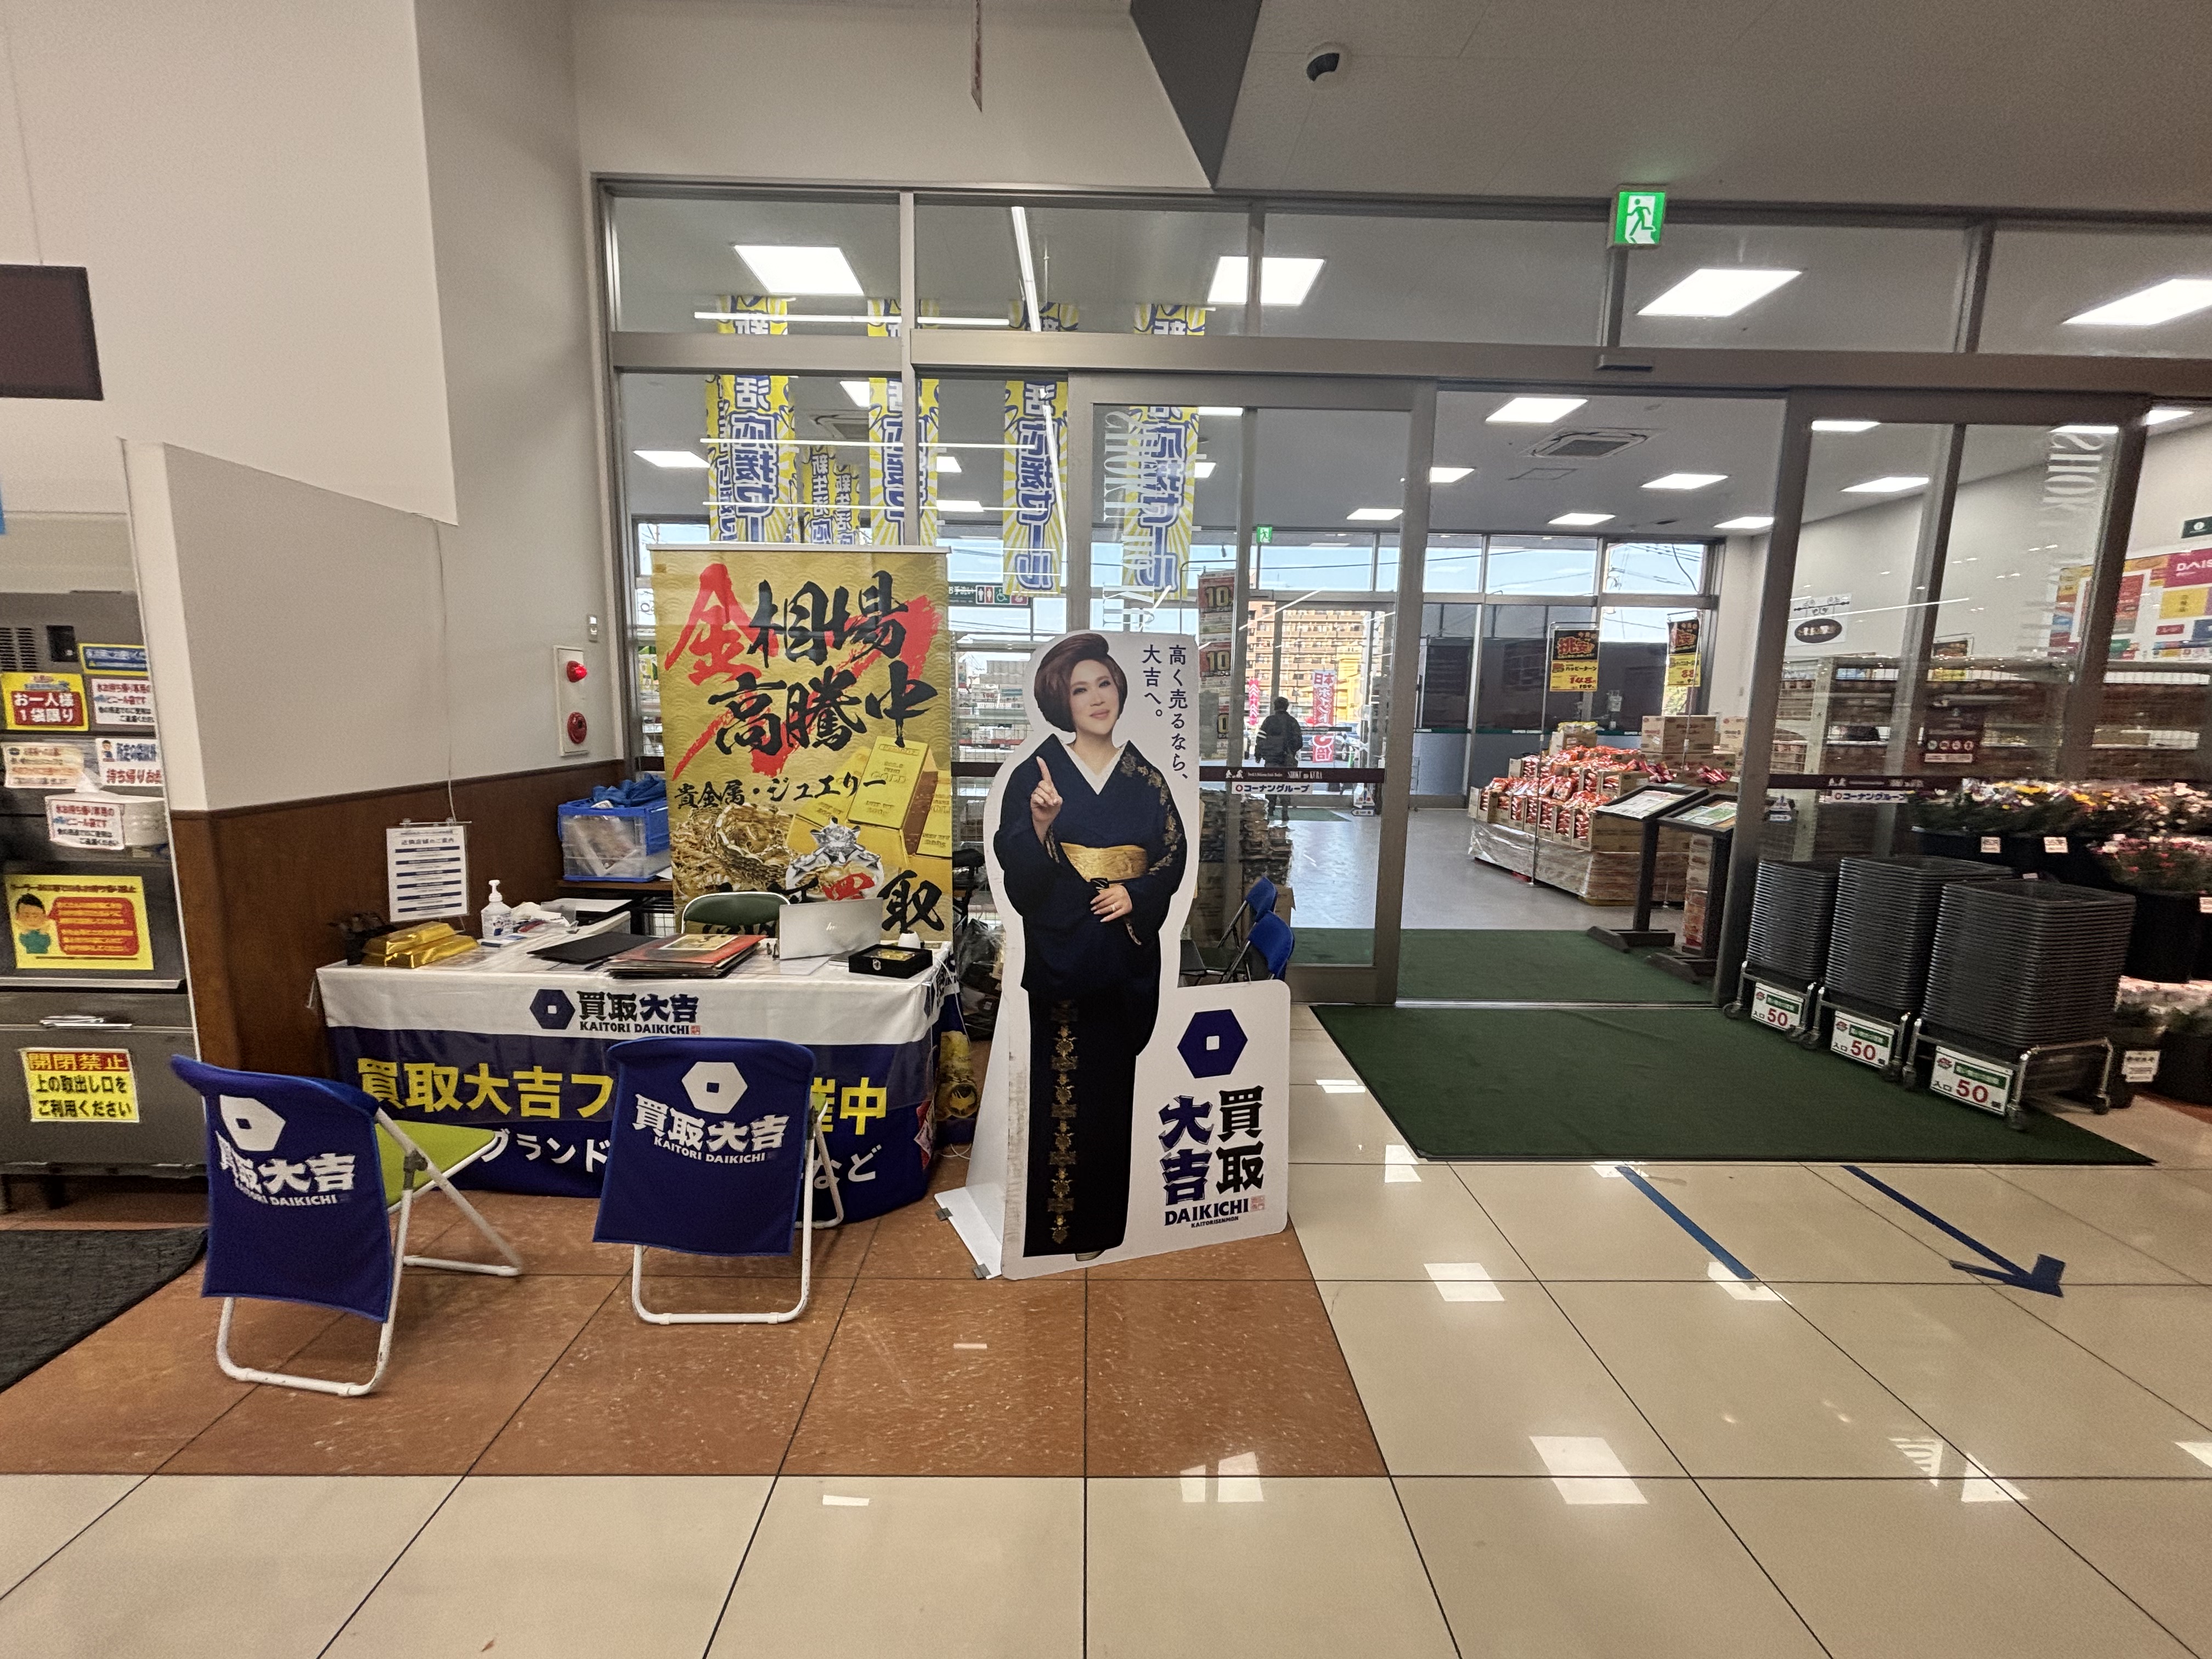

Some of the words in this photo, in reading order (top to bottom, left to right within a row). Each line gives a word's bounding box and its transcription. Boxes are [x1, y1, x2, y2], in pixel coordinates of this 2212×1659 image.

[665, 563, 909, 685] 金相場
[1141, 644, 1163, 717] 大吉へ。
[14, 693, 75, 707] お一人様
[708, 660, 938, 757] 高騰中
[1168, 644, 1188, 779] 高く売るなら、
[674, 772, 886, 809] 貴金属・ジュエリー
[1244, 784, 1310, 793] コーナングループ
[577, 990, 699, 1023] 買取大吉
[1767, 1008, 1788, 1026] 50
[579, 1021, 631, 1034] KAITORI
[634, 1023, 690, 1035] DAIKICHI
[28, 1053, 129, 1070] 開閉禁止
[1850, 1039, 1876, 1060] 50
[1956, 1079, 1989, 1103] 50
[38, 1099, 132, 1118] ご利用ください
[631, 1093, 789, 1153] 買取大吉
[653, 1136, 702, 1162] KAITORI
[705, 1151, 765, 1164] DAIKICHI
[1158, 1094, 1215, 1206] 大吉
[1216, 1085, 1265, 1195] 買取
[1164, 1198, 1250, 1227] DAIKICHI
